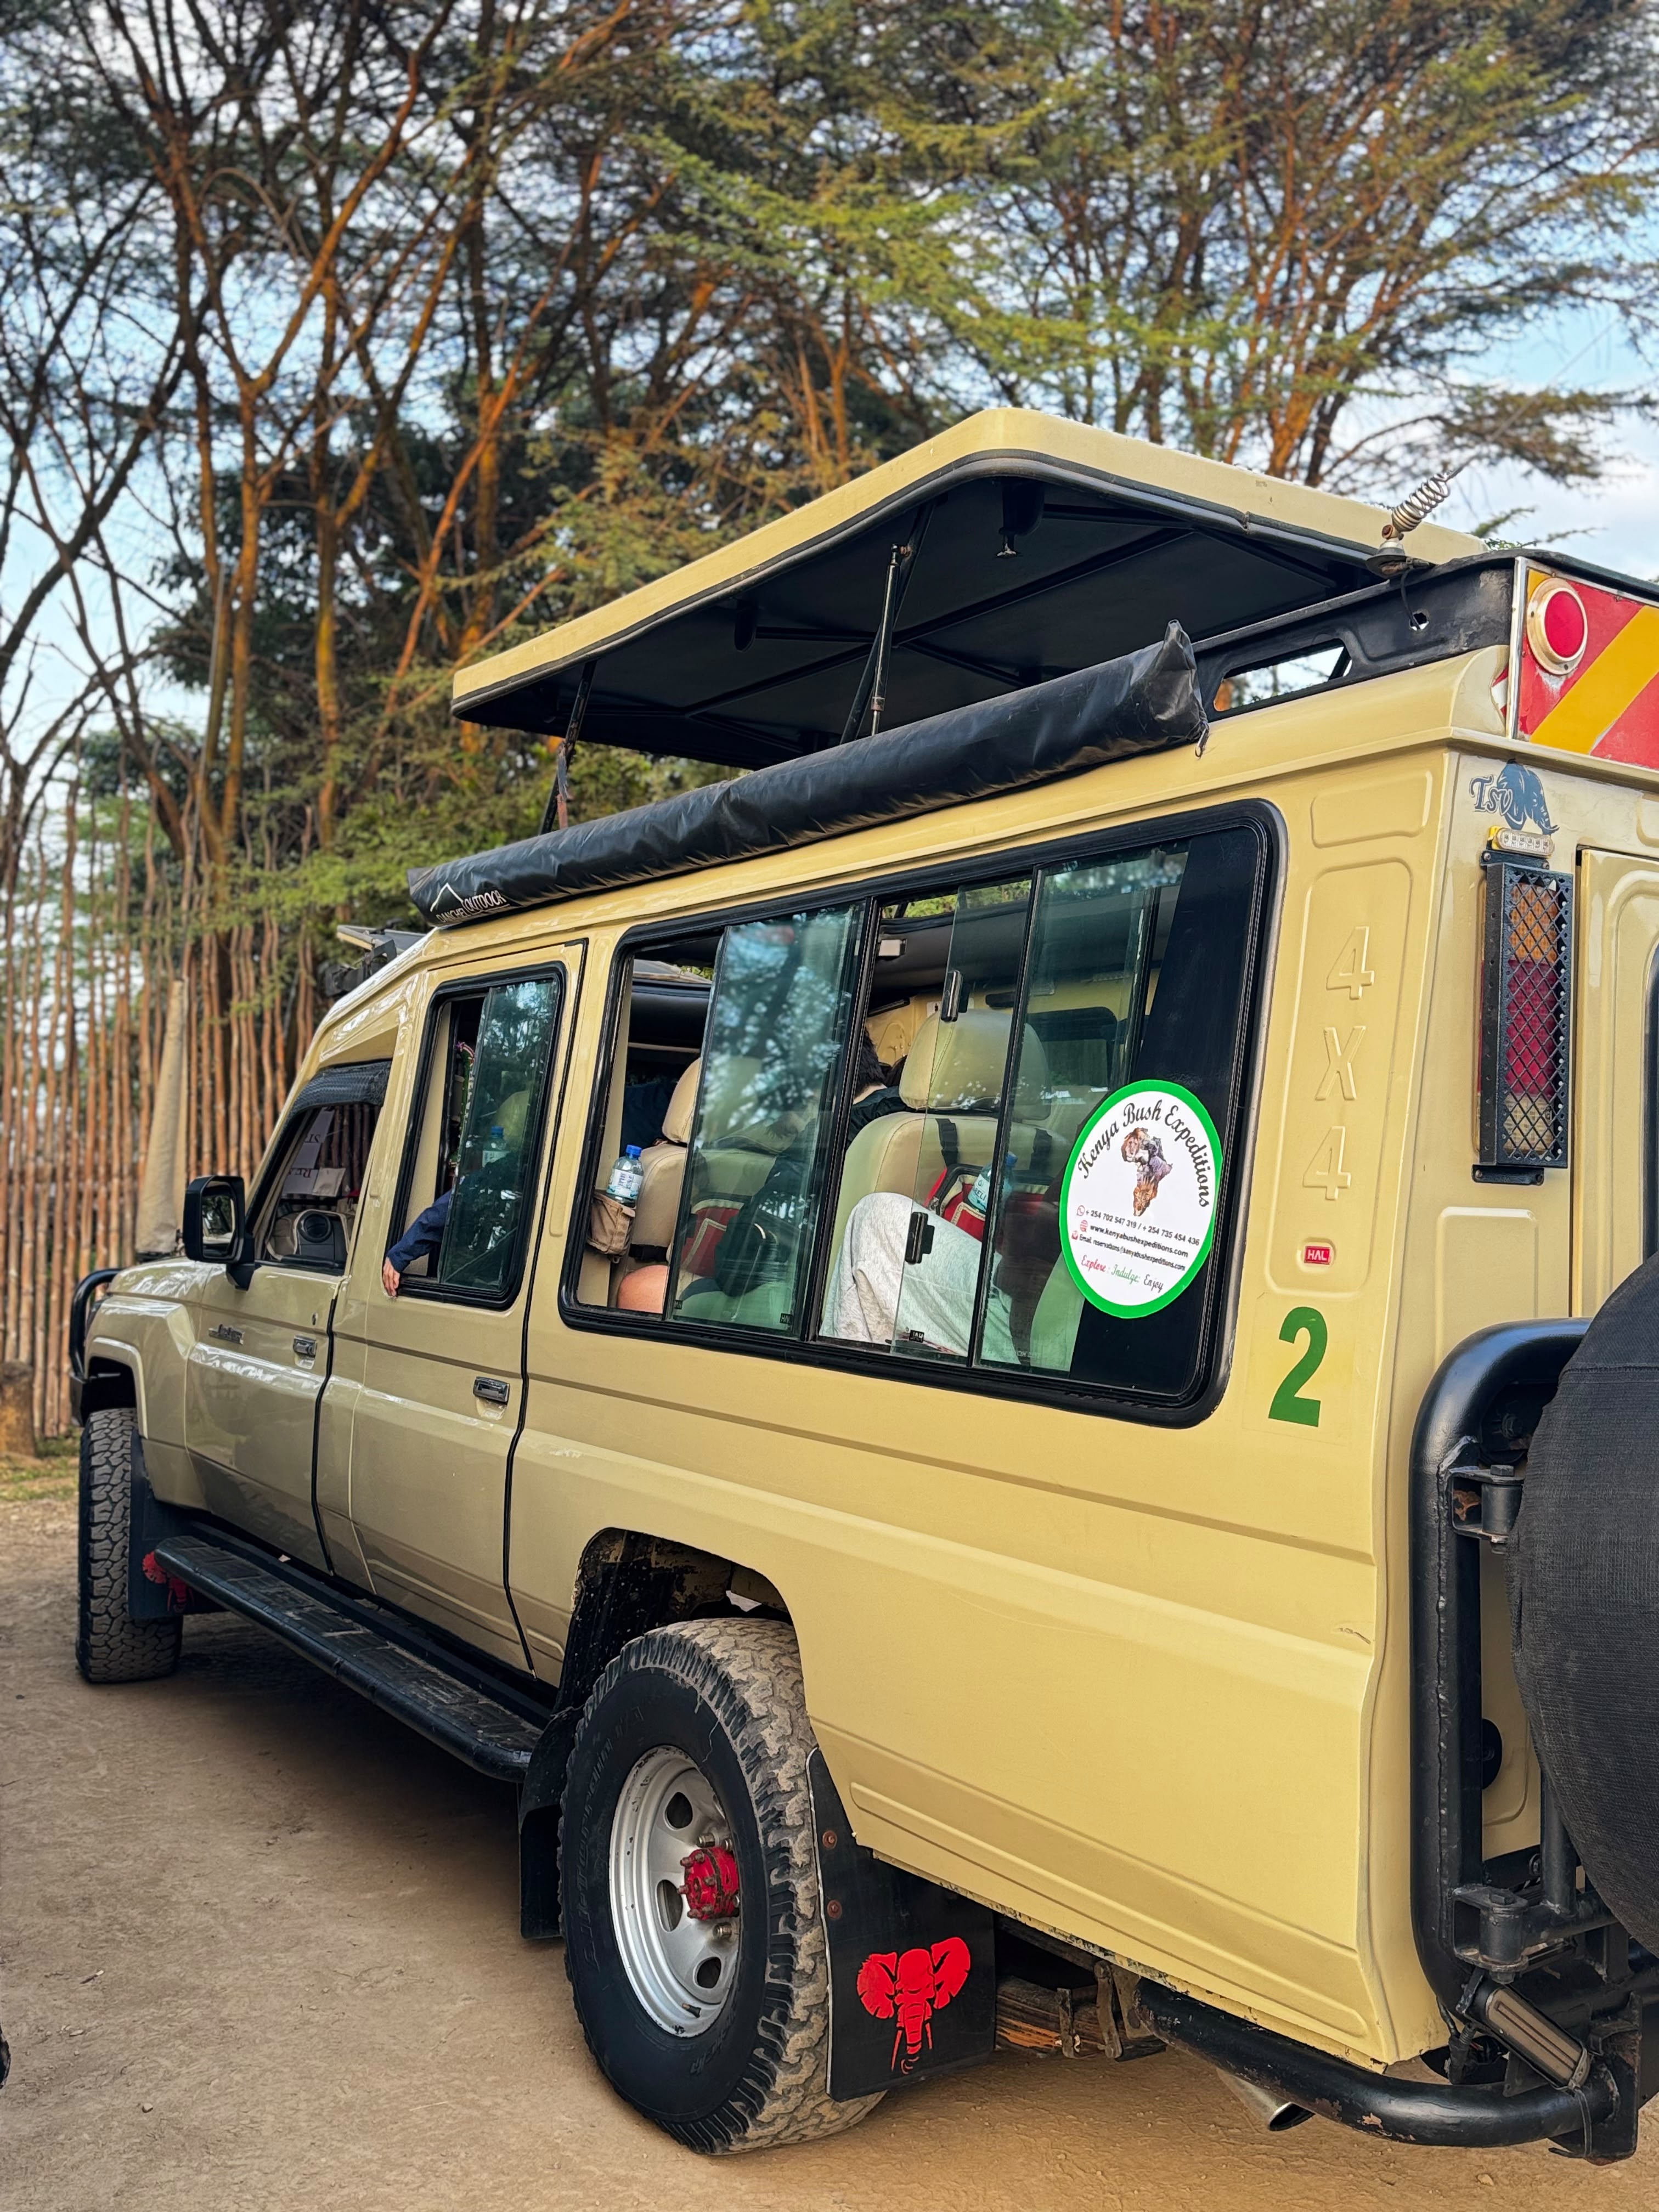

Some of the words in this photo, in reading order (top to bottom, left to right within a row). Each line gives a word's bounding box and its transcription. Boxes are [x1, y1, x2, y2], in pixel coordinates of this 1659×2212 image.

[464, 890, 507, 912] OUTDOOR
[1077, 1121, 1120, 1179] Kenya
[1123, 1099, 1163, 1127] Bush
[1164, 1105, 1210, 1207] Expeditions
[1090, 1224, 1188, 1257] www.kenyabushexpeditions.com
[1091, 1210, 1102, 1218] 254
[1103, 1213, 1113, 1222] 702
[1114, 1217, 1125, 1225] 547
[1126, 1220, 1137, 1228] 319
[1148, 1226, 1160, 1234] 254
[1161, 1229, 1173, 1238] 735
[1174, 1233, 1186, 1242] 454
[1188, 1237, 1200, 1246] 436
[1307, 1249, 1327, 1261] HAL
[1144, 1274, 1164, 1293] Enjoy
[1268, 1306, 1328, 1427] 2
